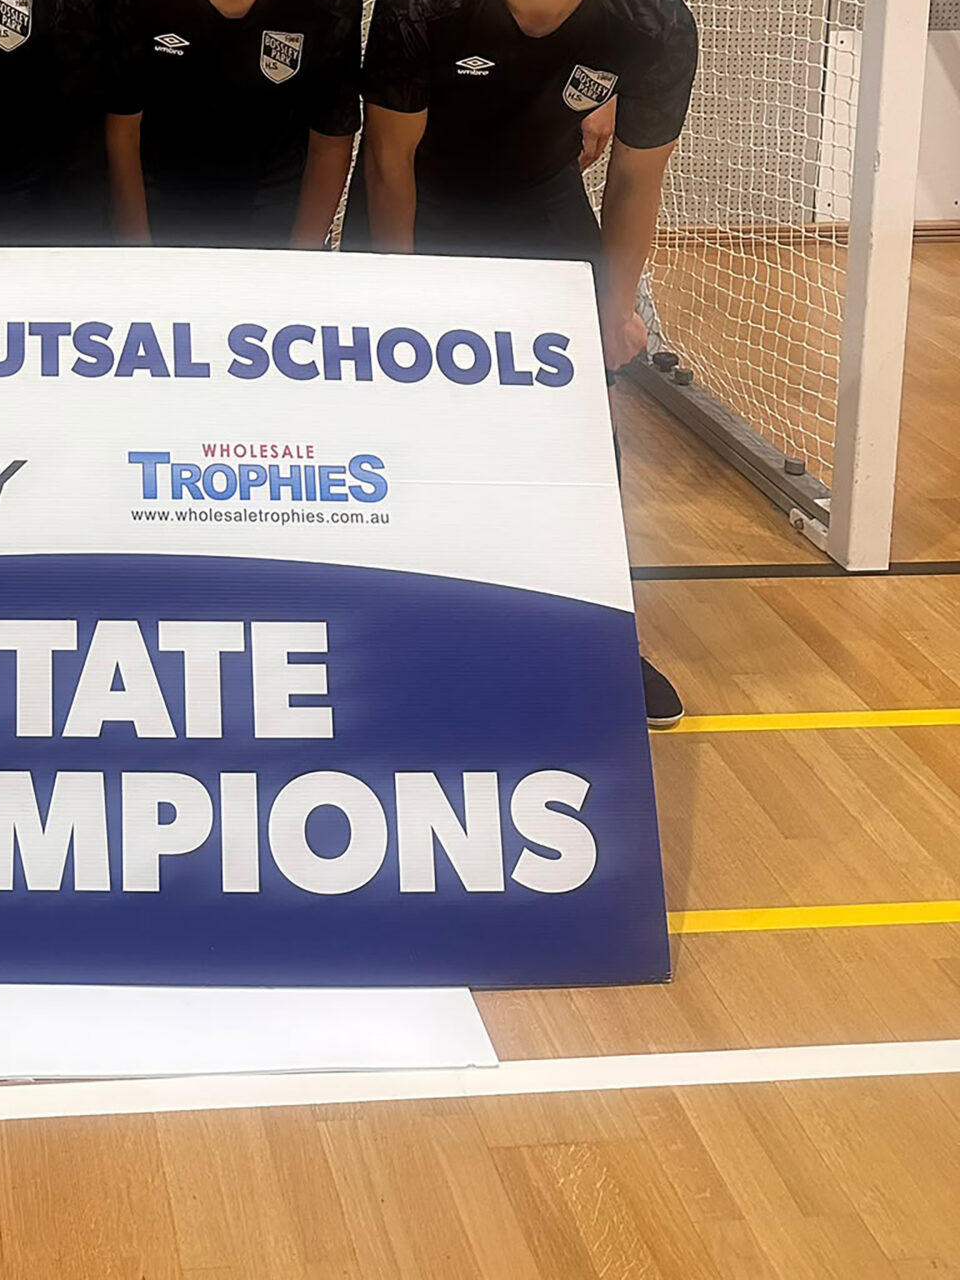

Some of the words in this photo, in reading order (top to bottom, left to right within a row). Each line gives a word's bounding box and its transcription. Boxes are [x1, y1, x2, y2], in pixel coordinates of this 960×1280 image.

[154, 45, 184, 56] umbro
[264, 34, 299, 60] BOSSLEY
[457, 68, 490, 76] umbro
[574, 68, 608, 97] BOSSLEY
[227, 323, 575, 388] SCHOOLS
[202, 443, 315, 460] WHOLESALE
[128, 451, 389, 504] TROPHIES
[131, 508, 390, 526] www.wholesaletrophies.com.au
